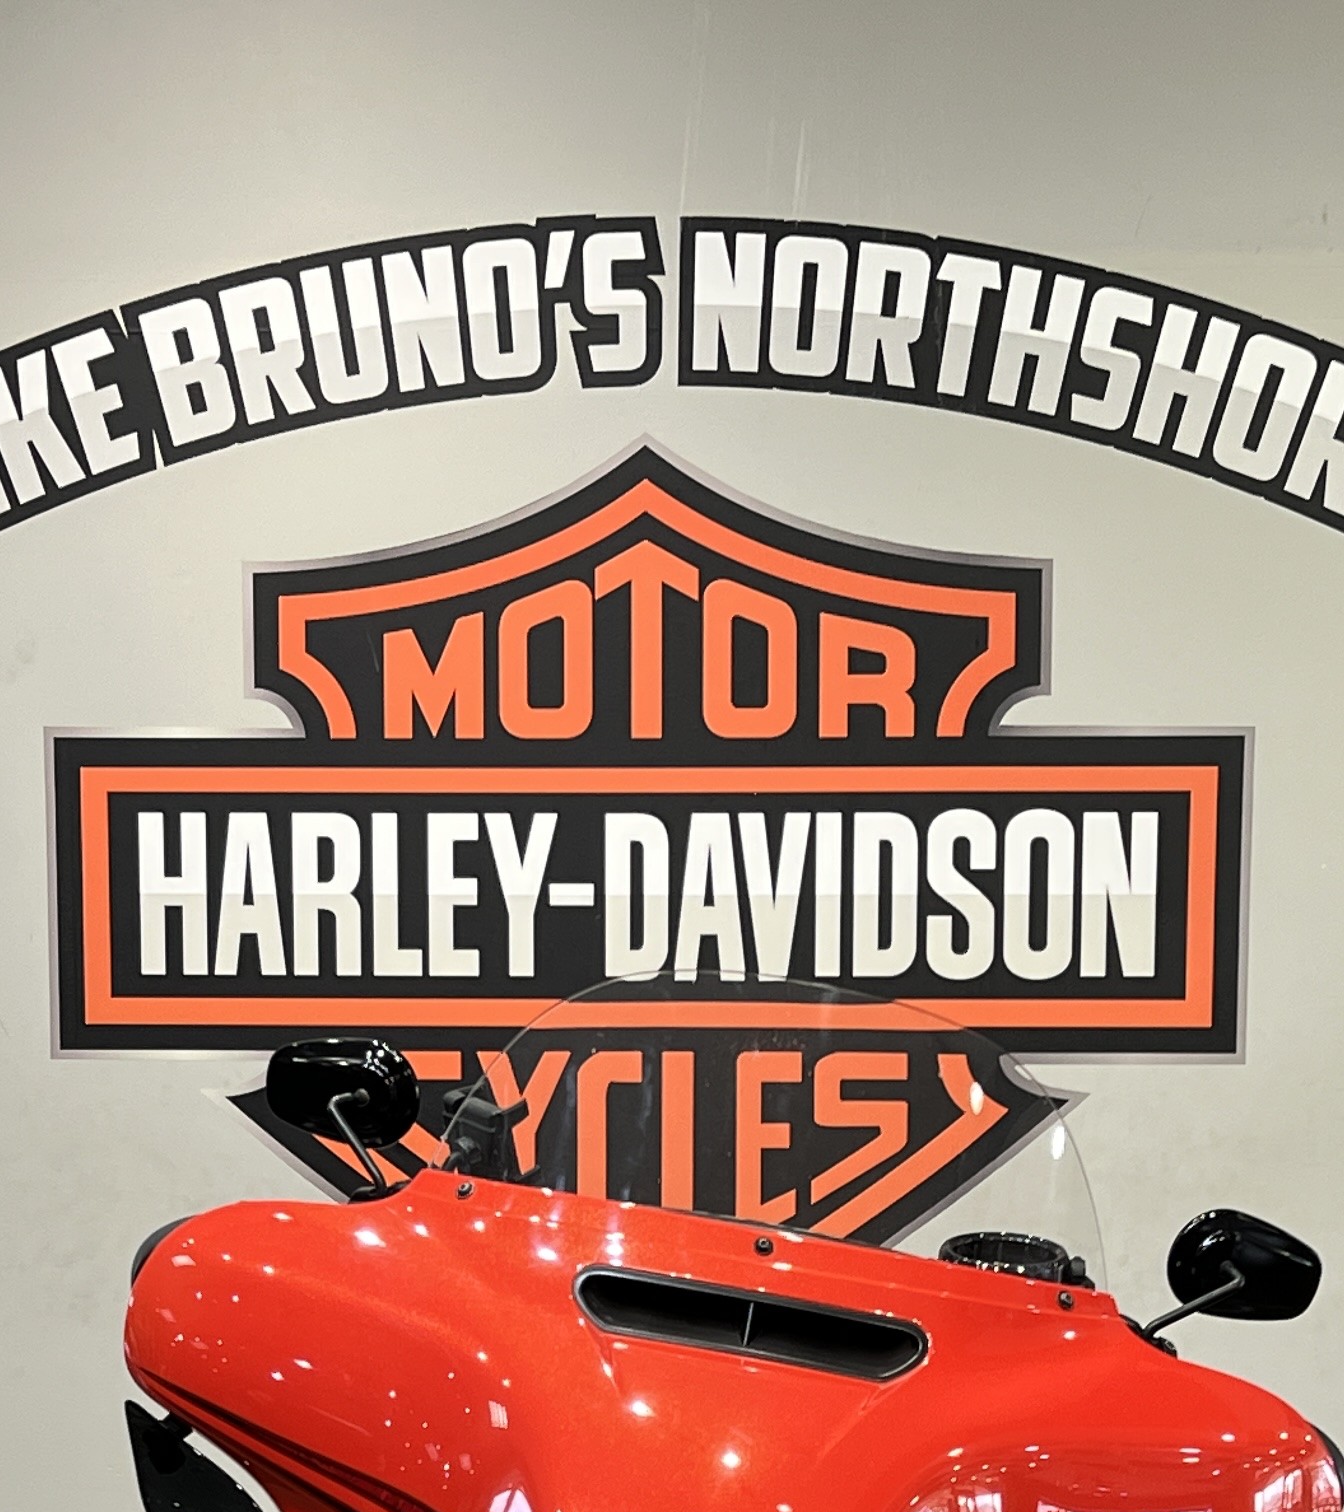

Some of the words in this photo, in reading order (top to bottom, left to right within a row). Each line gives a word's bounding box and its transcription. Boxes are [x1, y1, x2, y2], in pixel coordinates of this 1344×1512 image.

[138, 229, 647, 448] BRUNO'S
[383, 540, 916, 740] MOTOR
[137, 808, 1160, 982] HARLEY-DAVIDSON
